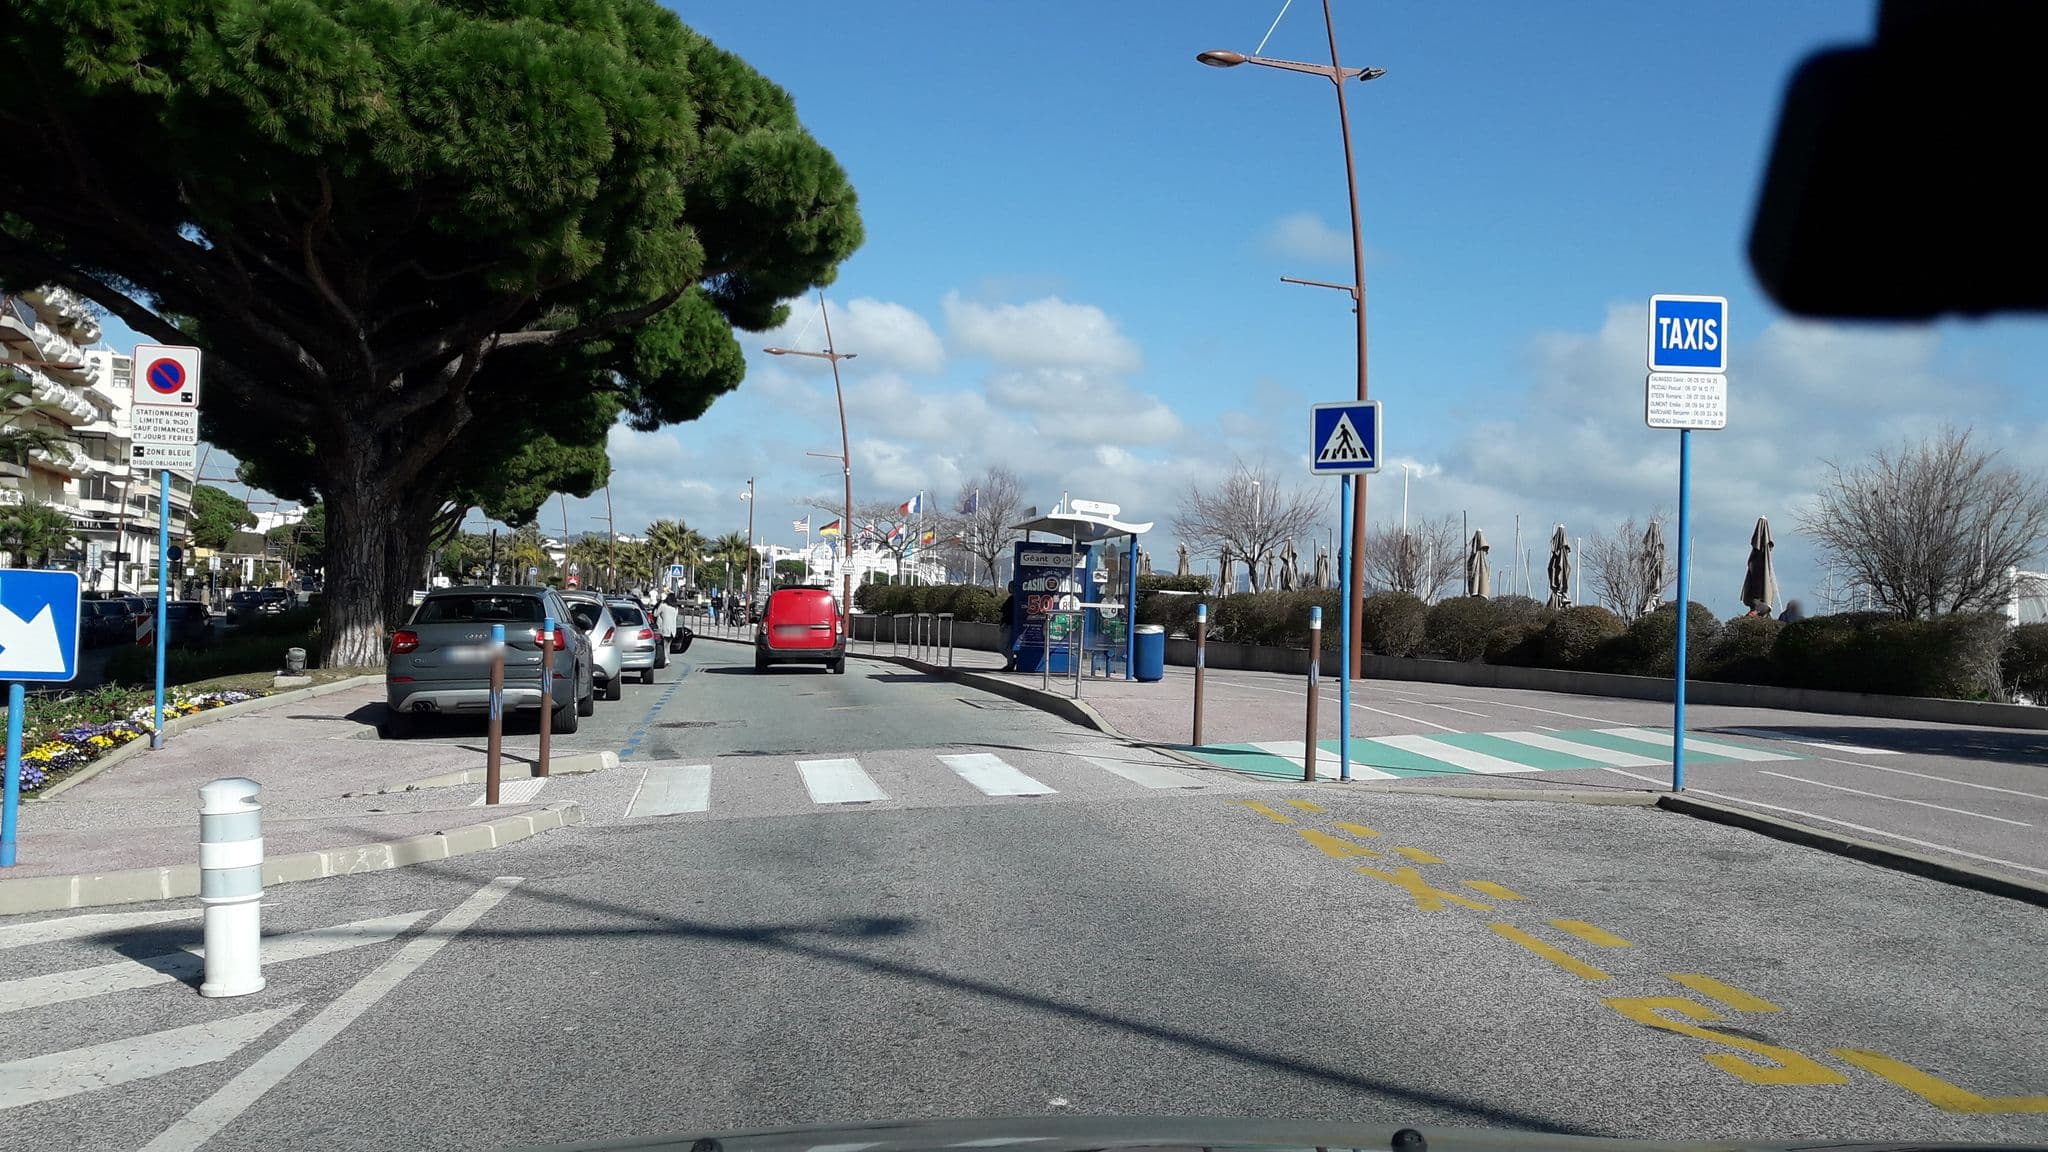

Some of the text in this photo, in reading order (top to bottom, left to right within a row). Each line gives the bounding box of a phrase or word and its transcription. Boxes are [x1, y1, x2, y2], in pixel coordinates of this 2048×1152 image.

[1659, 317, 1718, 351] TAXIS
[136, 409, 193, 417] STATIONNEMENT
[1023, 553, 1049, 562] Géant
